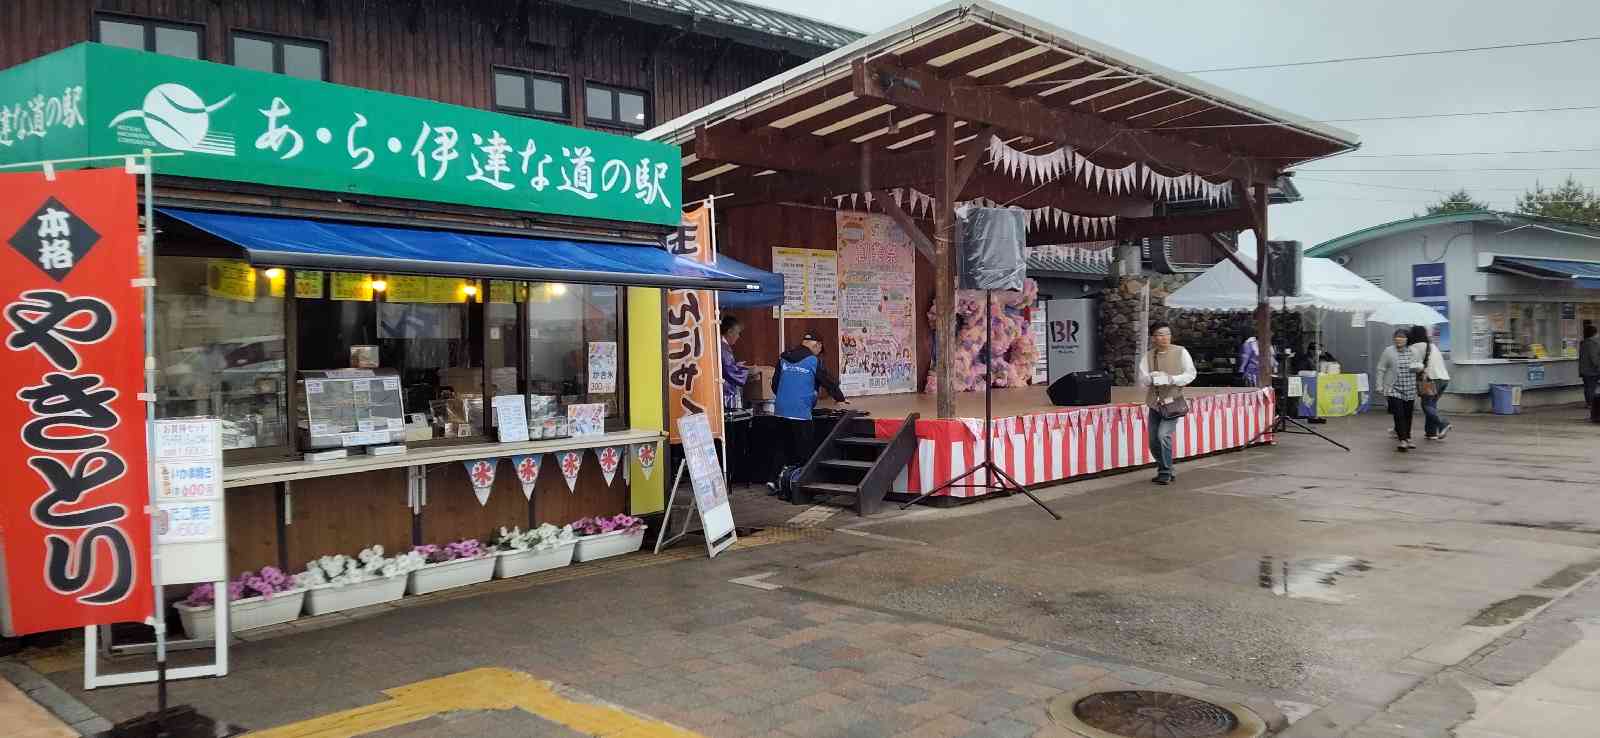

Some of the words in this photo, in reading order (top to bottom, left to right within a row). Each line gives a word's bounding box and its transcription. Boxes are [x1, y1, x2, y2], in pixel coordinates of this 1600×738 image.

[255, 97, 672, 208] あ・ら・伊達な道の駅
[37, 207, 74, 270] 本格
[5, 288, 135, 605] やきとり
